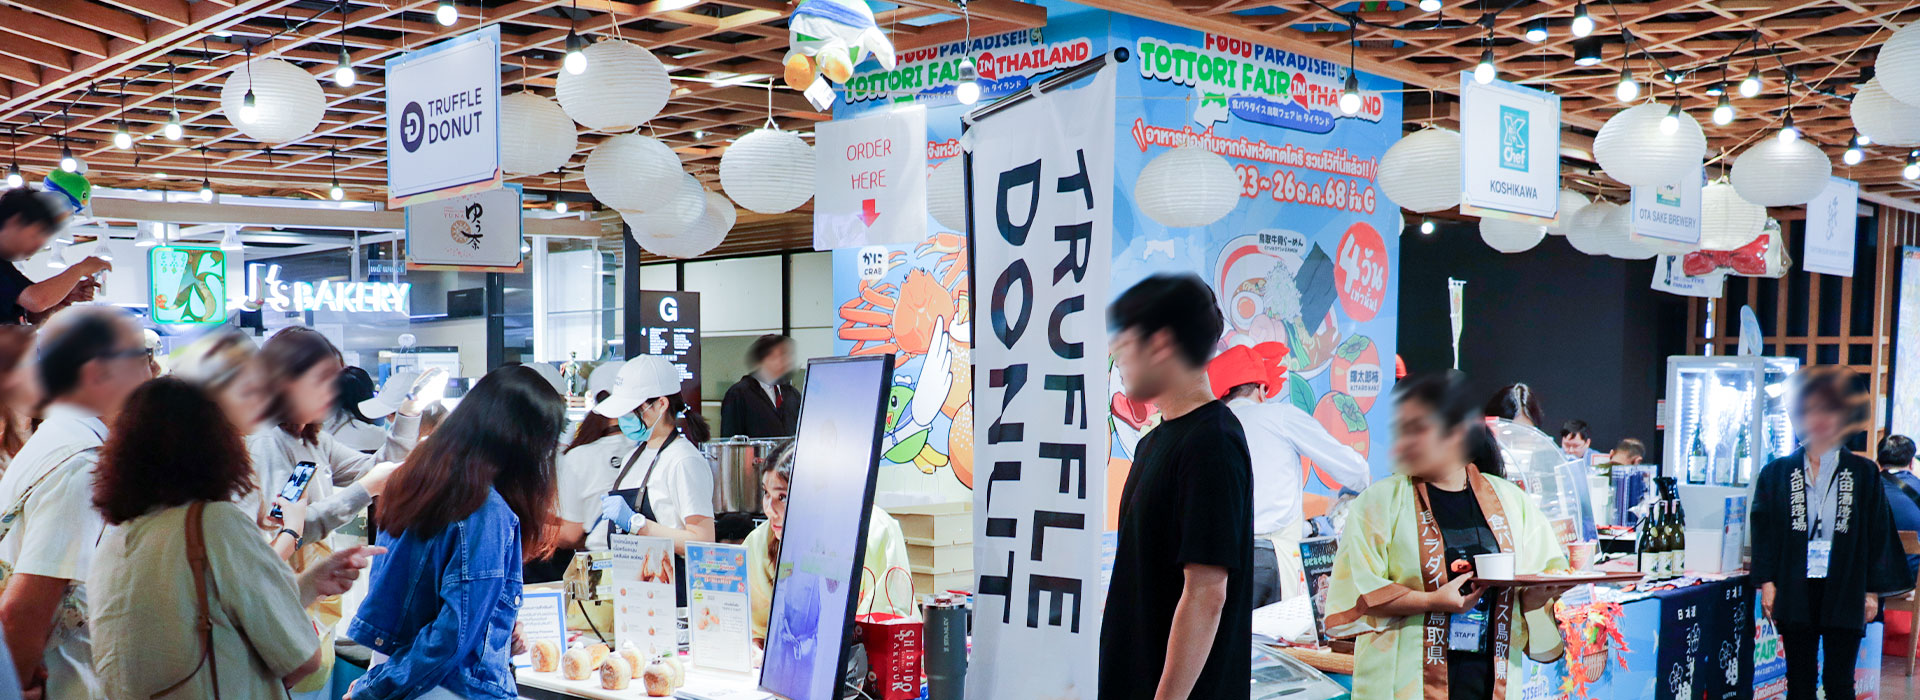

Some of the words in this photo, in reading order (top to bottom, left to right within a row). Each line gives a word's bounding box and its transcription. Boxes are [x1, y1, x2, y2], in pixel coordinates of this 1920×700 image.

[845, 64, 922, 100] TOTTORI
[978, 56, 995, 73] IN
[996, 41, 1089, 75] THAILAND
[1140, 42, 1237, 88] TOTTORI
[1242, 63, 1291, 99] FAIR
[1292, 78, 1308, 98] IN
[1205, 32, 1252, 59] FOOD
[1254, 44, 1336, 78] PARADISE!!
[427, 87, 483, 118] TRUFFLE
[428, 110, 483, 145] DONUT
[846, 138, 892, 162] ORDER
[851, 169, 887, 190] HERE
[1489, 179, 1538, 201] KOSHIKAWA
[1363, 188, 1376, 213] G
[1639, 208, 1651, 221] OTA
[1652, 210, 1668, 224] SAKE
[1668, 213, 1697, 230] BREWERY
[862, 251, 883, 265] かに
[863, 267, 883, 276] CRAB
[294, 279, 413, 313] BAKERY
[658, 295, 679, 322] G
[977, 158, 1042, 625] DONUT
[1026, 148, 1095, 634] TRUFFLE
[1790, 467, 1808, 532] 太田酒造場
[1834, 467, 1854, 534] 太田酒造場
[1454, 631, 1476, 639] STAFF
